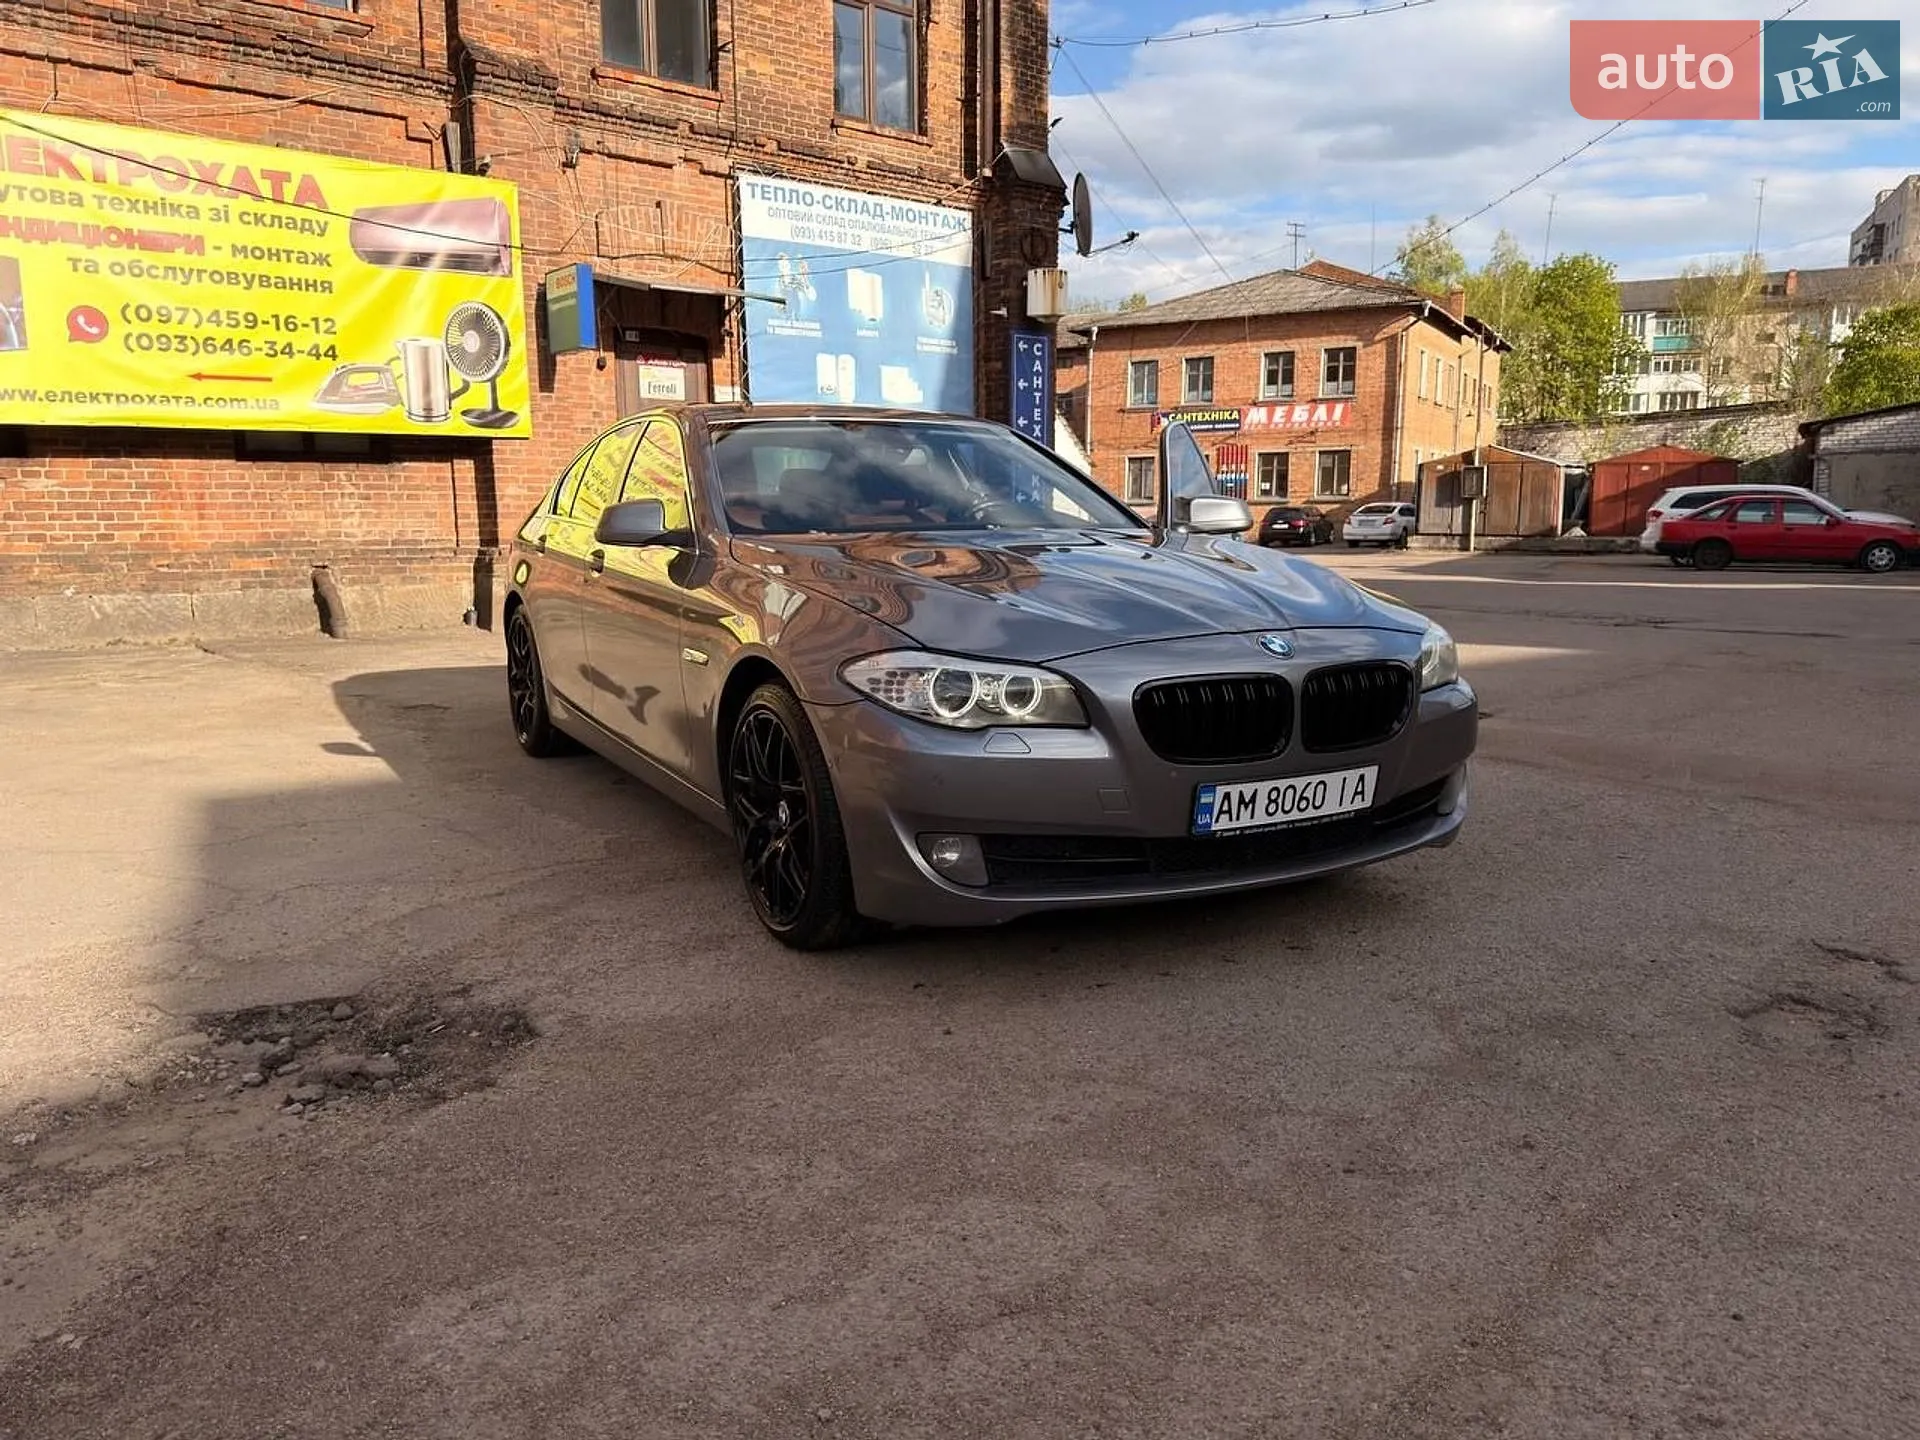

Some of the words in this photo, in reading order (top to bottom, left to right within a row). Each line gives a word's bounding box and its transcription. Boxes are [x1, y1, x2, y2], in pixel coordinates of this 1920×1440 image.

[0, 132, 329, 210] ЕКТРОХАТА
[93, 194, 200, 220] техніка
[208, 205, 230, 224] зі
[238, 211, 329, 237] складу
[746, 182, 966, 231] ТЕПЛО-СКЛАД-МОНТАЖ
[815, 213, 846, 229] СКЛАД
[231, 243, 332, 268] монтаж
[66, 257, 99, 275] та
[109, 260, 334, 294] обслуговування
[121, 302, 337, 336] (097)459-16-12
[124, 332, 339, 361] (093)646-34-44
[1168, 409, 1240, 422] САНТЕХНІКА
[1243, 403, 1345, 424] МЕБЛІ
[1214, 787, 1258, 823] AM
[1265, 780, 1327, 817] 8060
[1339, 773, 1366, 807] IA
